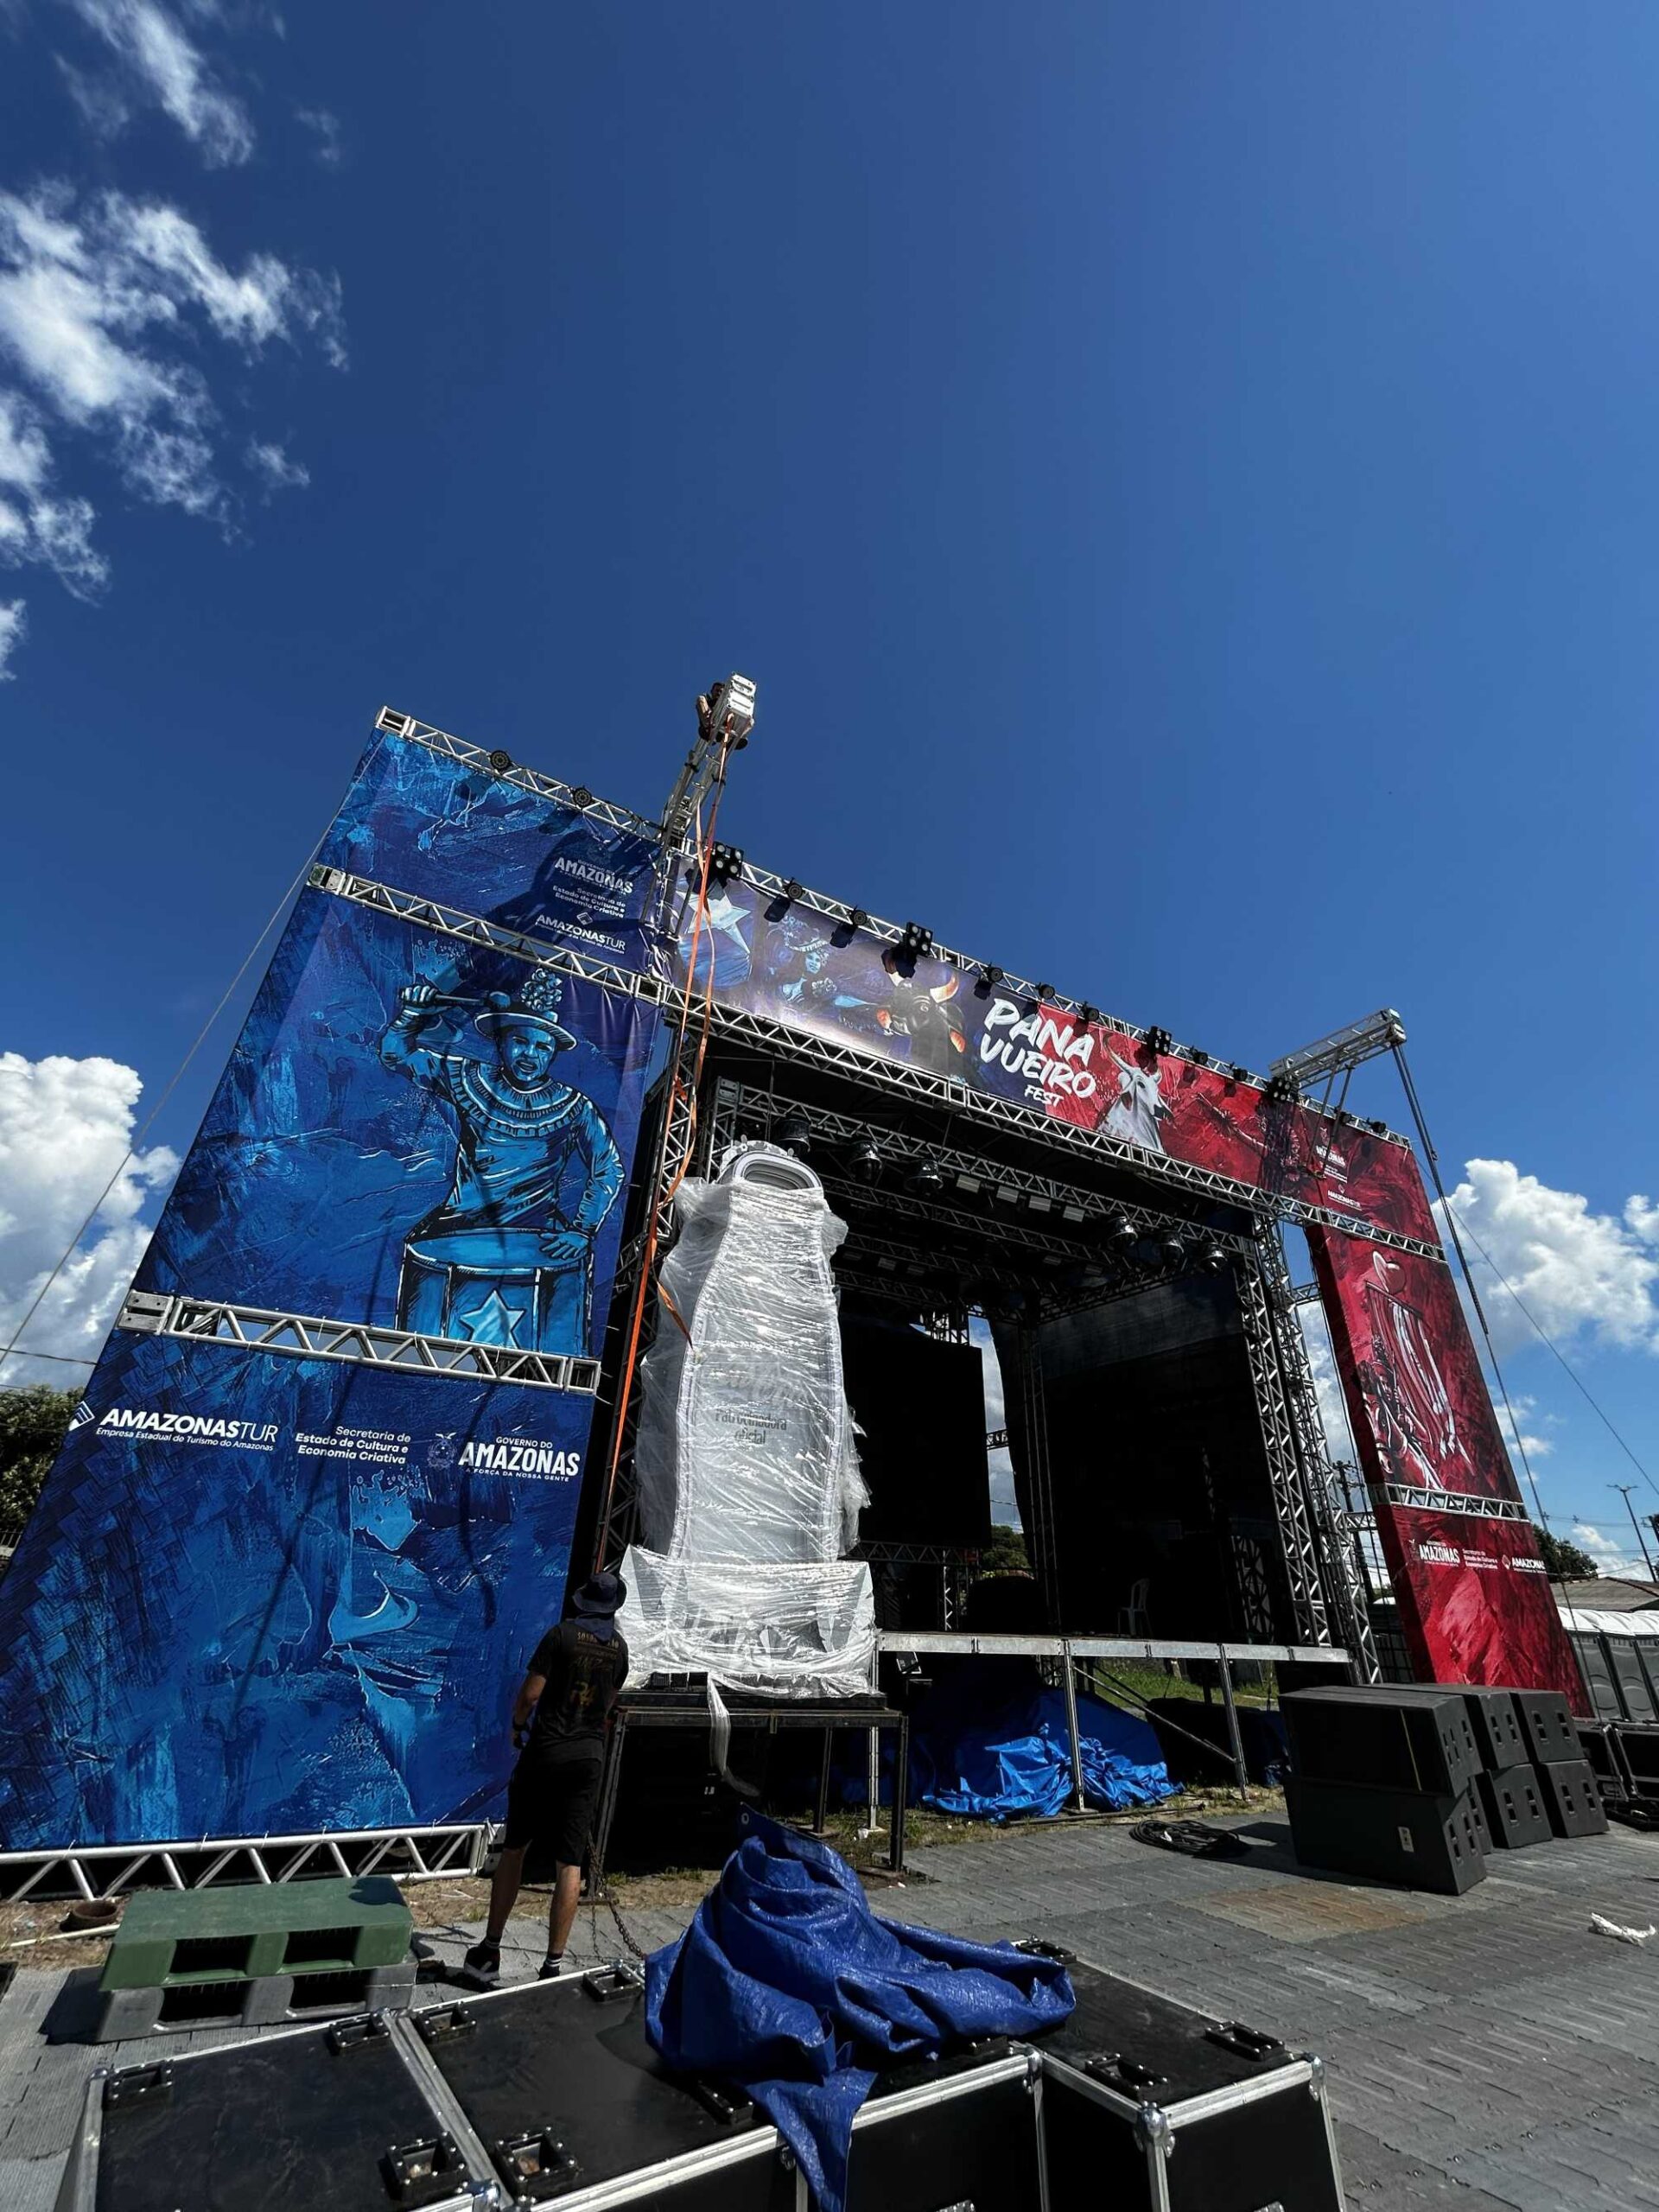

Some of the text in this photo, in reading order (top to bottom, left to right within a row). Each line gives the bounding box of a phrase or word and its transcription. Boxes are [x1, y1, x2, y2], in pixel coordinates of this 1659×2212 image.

[554, 857, 634, 894] AMAZONAS
[553, 885, 579, 899] Estado
[593, 905, 625, 918] Criativa
[536, 914, 626, 951] AMAZONASTUR
[984, 997, 1096, 1067] PANA
[980, 1033, 1096, 1099] VUEIRO
[1024, 1084, 1065, 1108] FEST
[99, 1408, 279, 1443] AMAZONASTUR
[335, 1426, 411, 1443] Secretaria de
[95, 1427, 274, 1452] Empresa Estadual de Turismo do Amazonas
[295, 1433, 337, 1446] Estado
[339, 1438, 354, 1447] de
[356, 1440, 400, 1452] Cultura
[495, 1436, 538, 1447] GOVERNO
[297, 1445, 406, 1465] Economia Criativa
[458, 1441, 581, 1477] AMAZONAS
[1419, 1544, 1461, 1564] AMAZONAS
